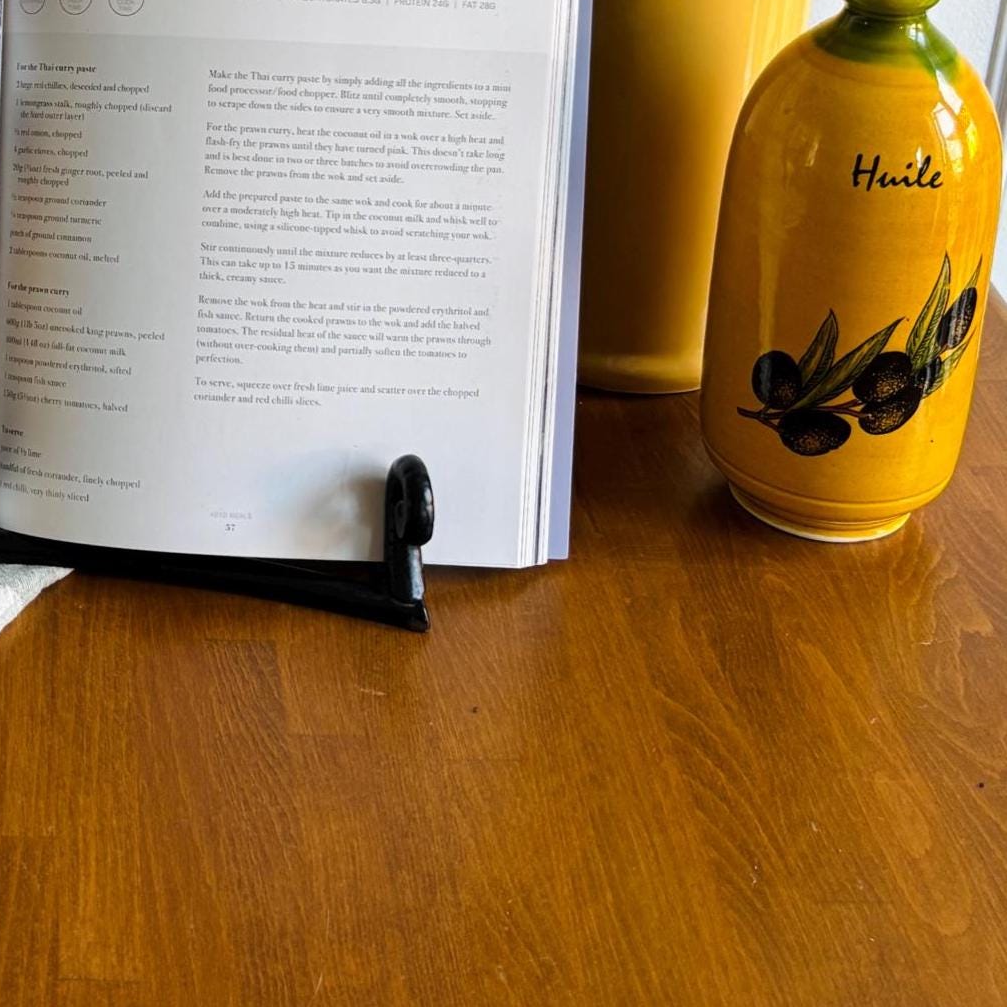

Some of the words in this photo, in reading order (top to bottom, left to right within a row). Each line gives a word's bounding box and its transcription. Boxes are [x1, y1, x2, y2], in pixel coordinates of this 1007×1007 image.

[461, 0, 477, 9] FAT
[209, 70, 232, 80] Make
[233, 71, 248, 80] the
[249, 71, 269, 81] Thai
[271, 75, 295, 85] curry
[296, 73, 320, 86] paste
[321, 74, 332, 87] by
[333, 75, 362, 88] simply
[364, 76, 394, 89] adding
[396, 78, 406, 87] all
[407, 78, 422, 88] the
[423, 79, 473, 93] ingredients
[475, 81, 483, 90] to
[853, 154, 943, 192] Huile
[200, 242, 217, 252] Stir
[217, 243, 274, 257] continuously
[276, 245, 298, 255] until
[299, 246, 313, 256] the
[314, 247, 349, 257] mixture
[349, 248, 383, 259] reduces
[385, 250, 395, 262] by
[396, 250, 405, 260] at
[407, 251, 427, 261] least
[199, 270, 225, 283] thick,
[225, 274, 257, 285] creamy
[258, 276, 285, 284] sauce.
[28, 286, 48, 295] prawn
[50, 288, 69, 298] curry
[193, 392, 235, 403] coriander
[237, 395, 253, 404] and
[255, 396, 269, 405] red
